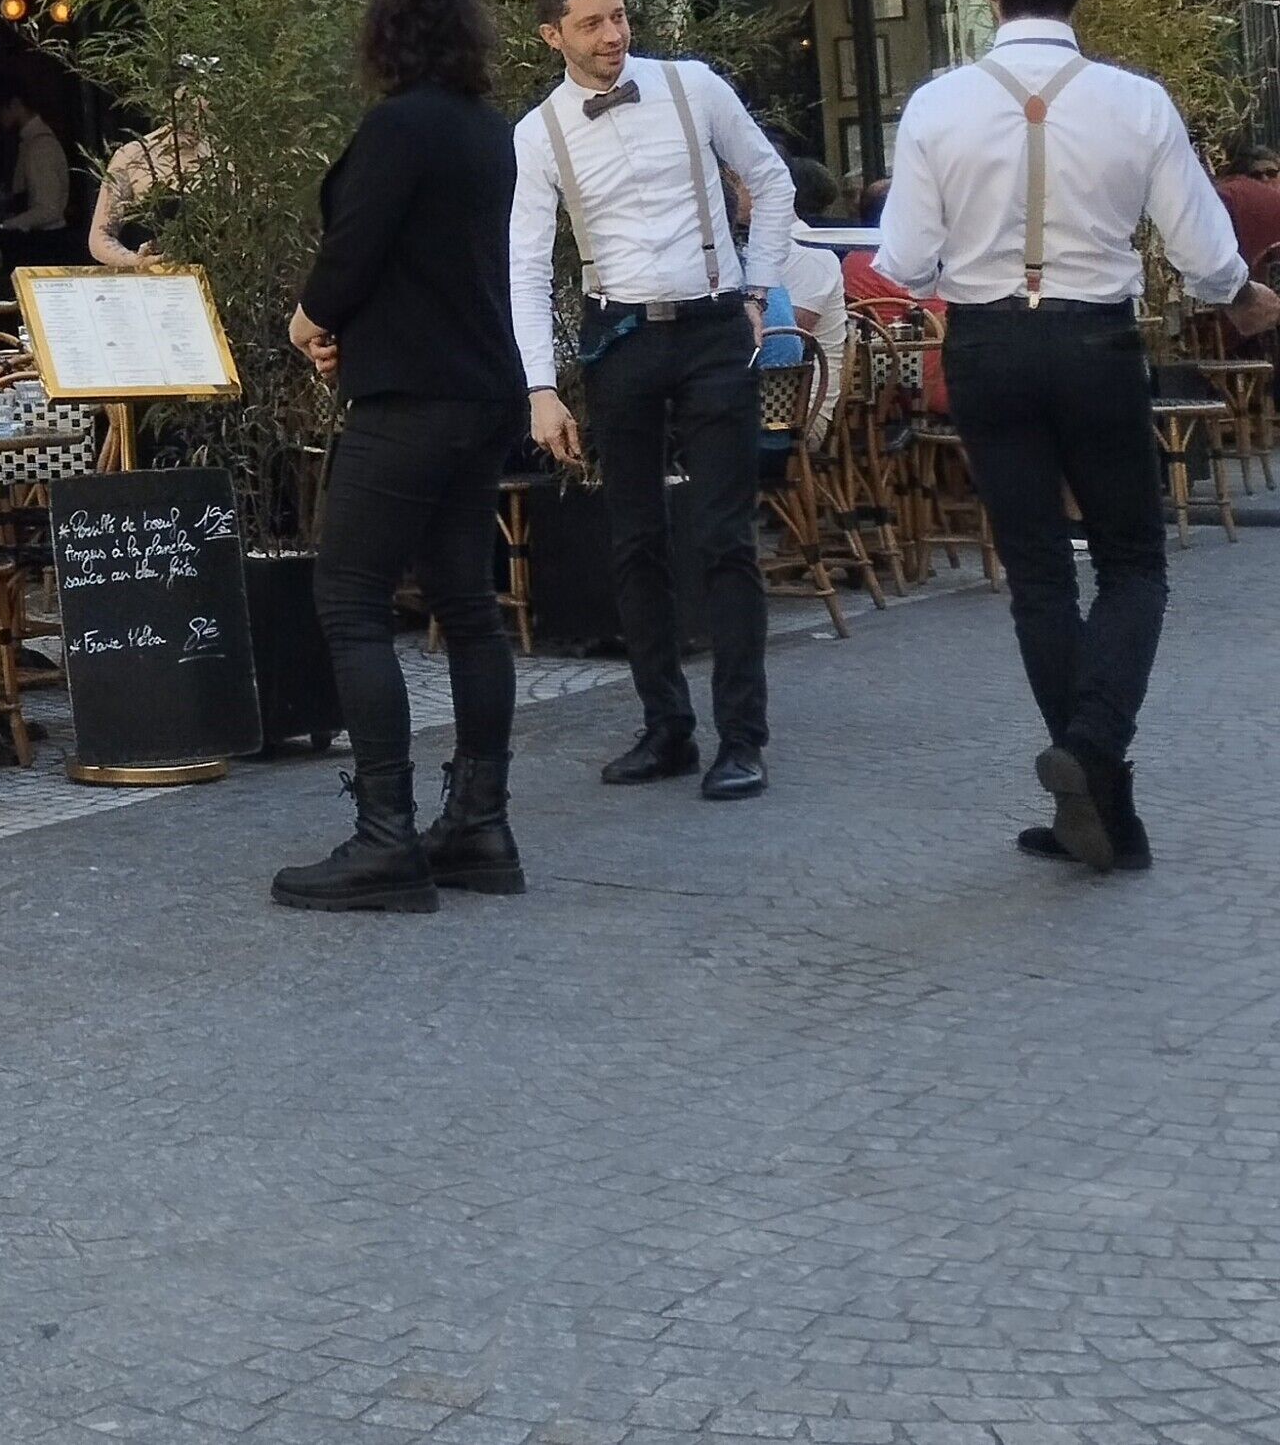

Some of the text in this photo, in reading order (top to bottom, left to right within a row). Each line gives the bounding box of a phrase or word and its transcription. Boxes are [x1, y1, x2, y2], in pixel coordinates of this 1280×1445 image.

[121, 515, 138, 534] de
[127, 534, 143, 559] la
[63, 572, 107, 590] sauce
